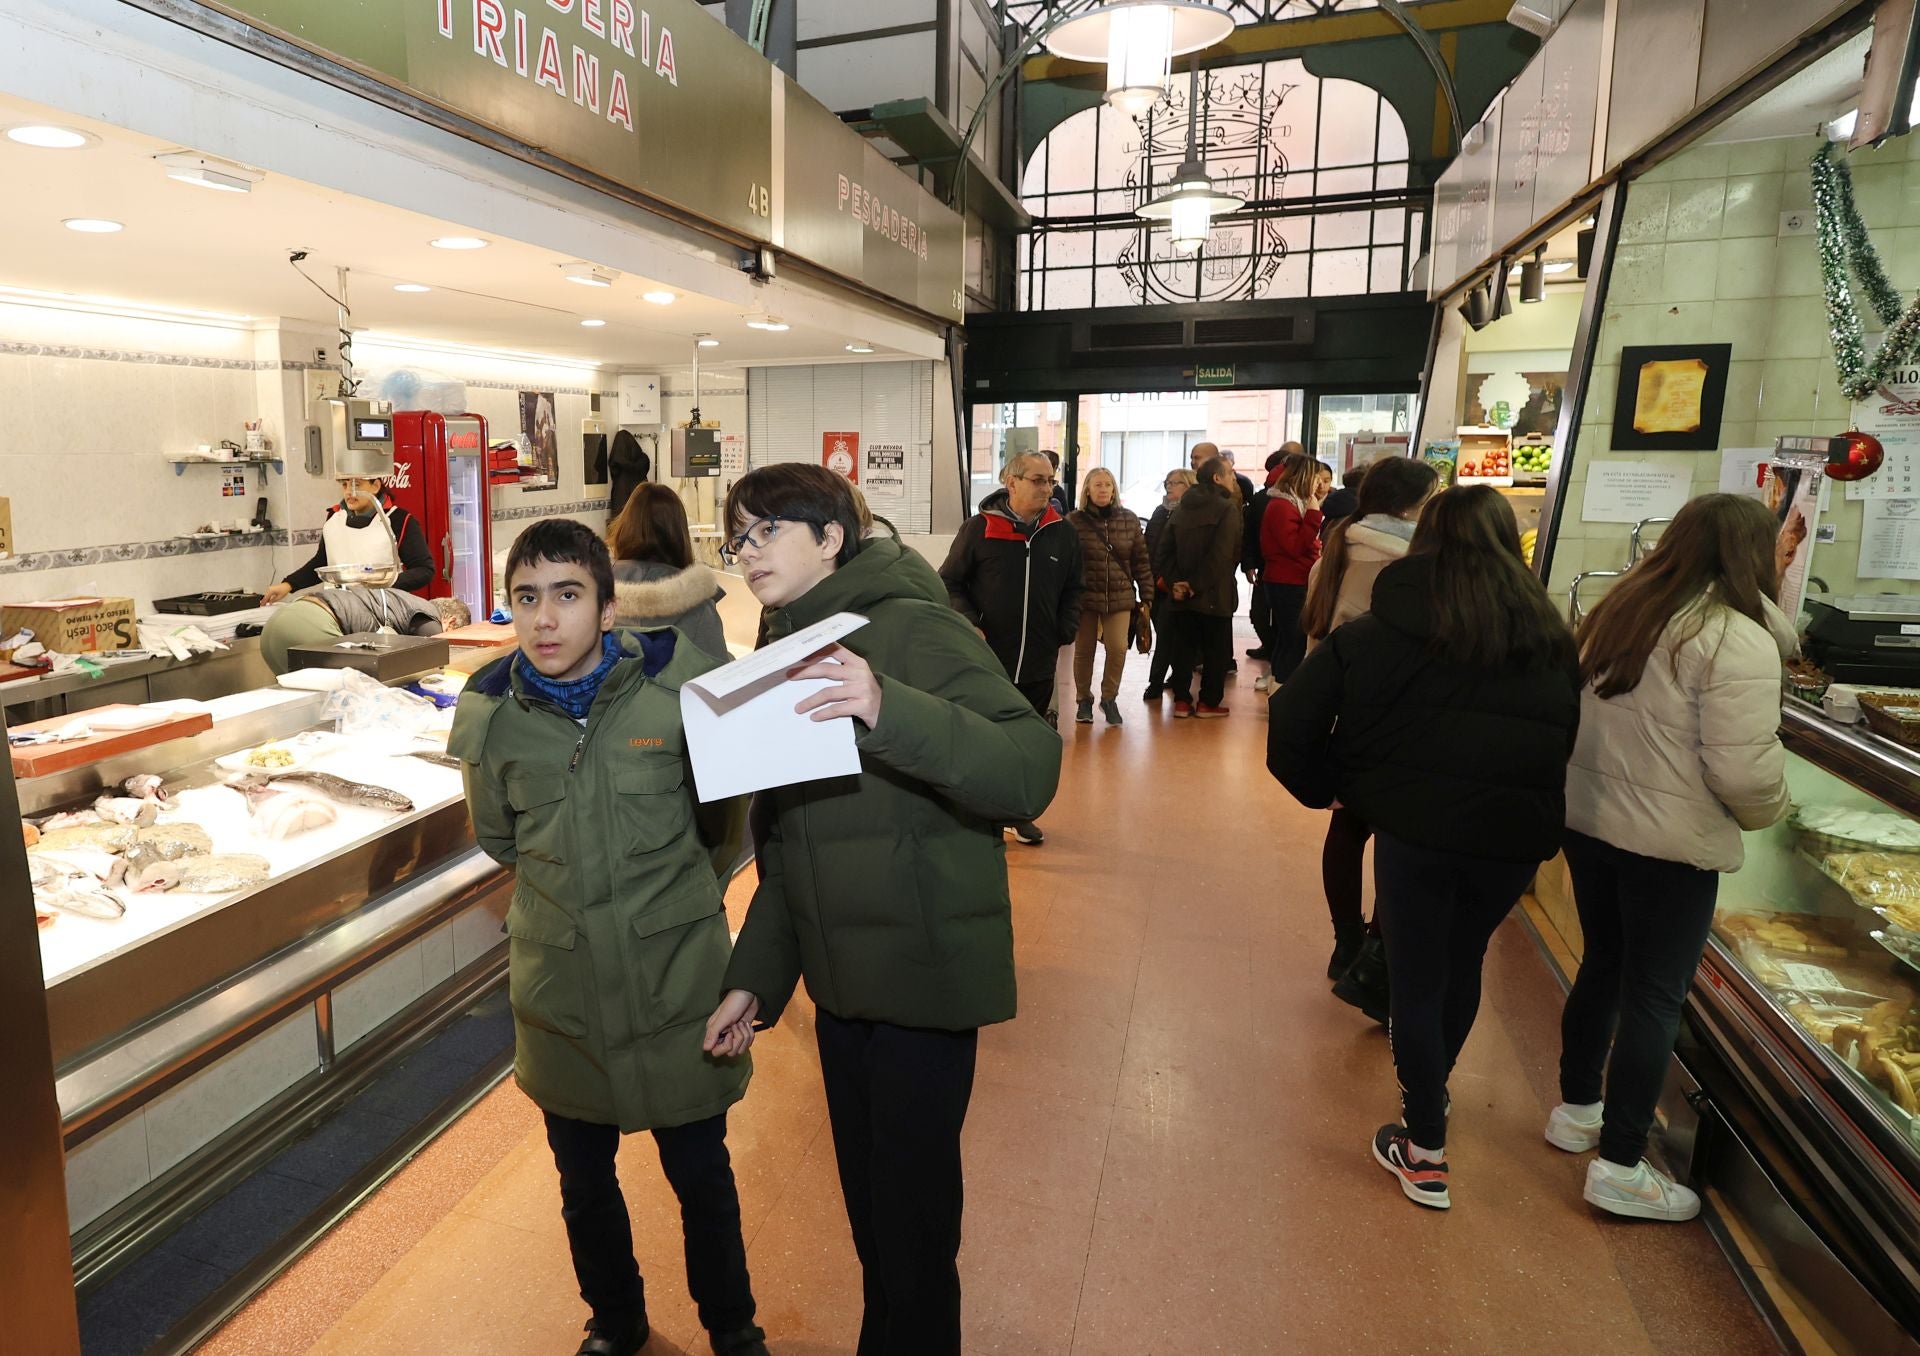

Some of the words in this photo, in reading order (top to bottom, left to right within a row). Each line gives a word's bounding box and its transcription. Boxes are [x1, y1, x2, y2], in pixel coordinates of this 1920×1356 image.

[546, 0, 678, 87] ERIA
[838, 173, 928, 262] PESCADERIA
[1199, 368, 1233, 378] SALIDA
[1888, 370, 1920, 384] ALO
